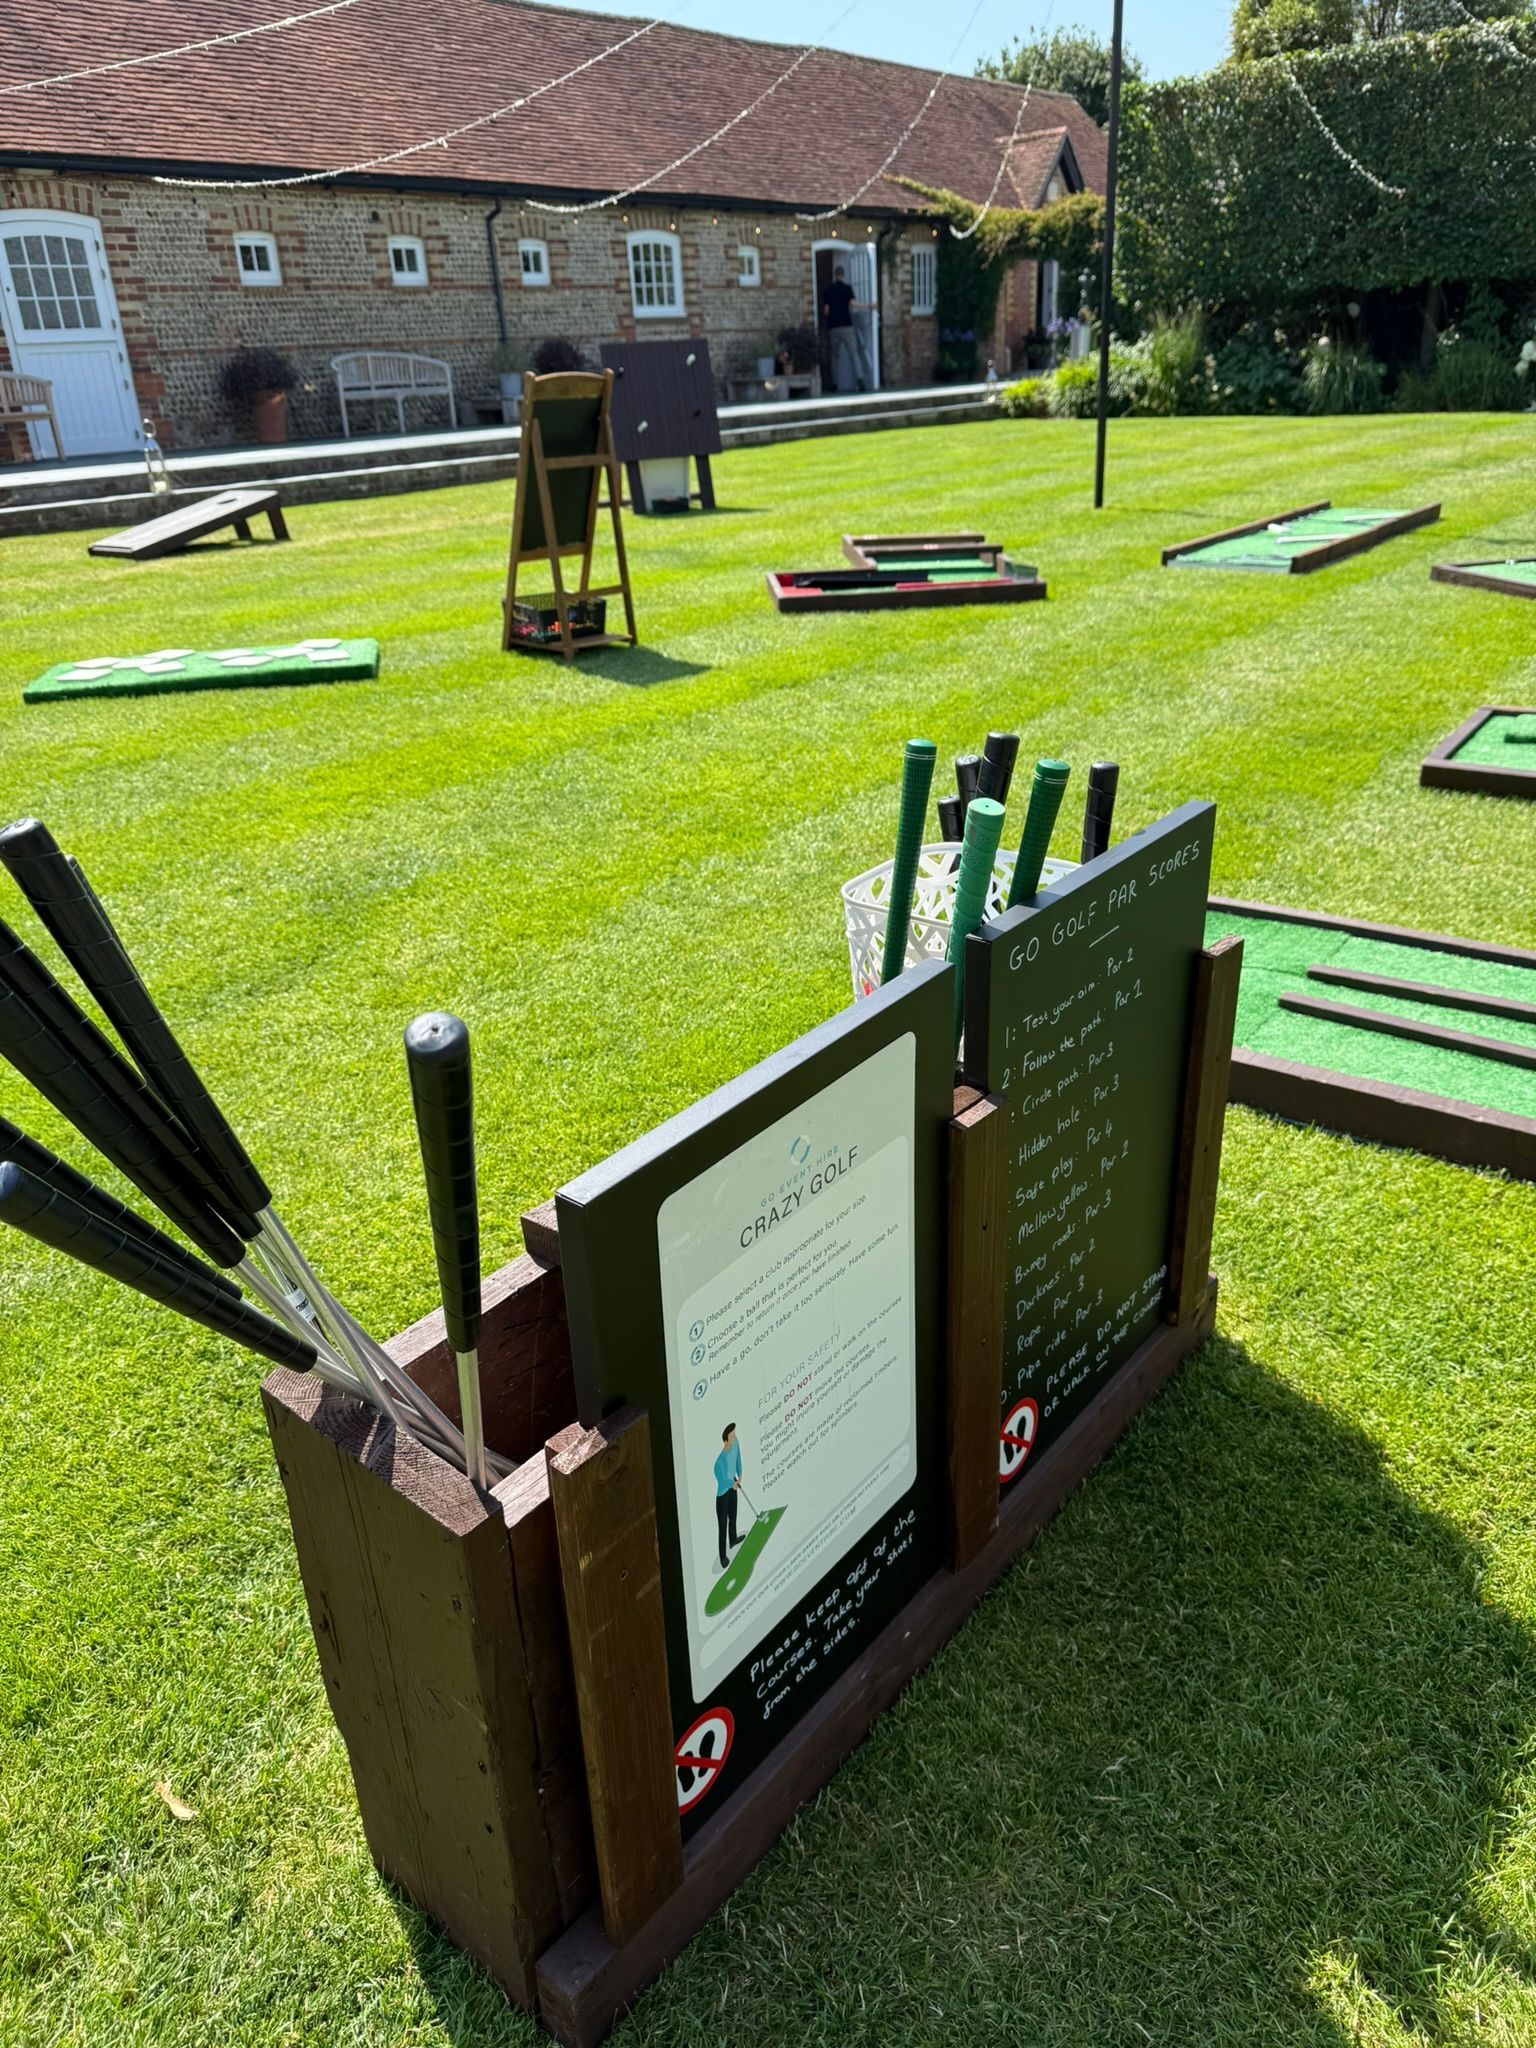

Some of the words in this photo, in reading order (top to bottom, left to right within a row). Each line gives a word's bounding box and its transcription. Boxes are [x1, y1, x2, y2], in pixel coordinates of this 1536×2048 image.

[1009, 936, 1040, 970] GO
[1051, 901, 1097, 945] GOLF
[1108, 880, 1137, 913] PAR
[1148, 840, 1200, 886] SCORES
[1002, 1067, 1017, 1089] 2:
[1022, 1050, 1056, 1078] Follow
[1059, 1035, 1076, 1053] the
[1080, 1007, 1107, 1046] path:
[1115, 990, 1131, 1011] Par
[1133, 978, 1143, 999] 1
[1005, 1026, 1016, 1049] 1:
[1022, 1011, 1049, 1033] Test
[1050, 995, 1075, 1025] your
[1077, 974, 1101, 999] aim:
[1107, 957, 1123, 977] Par
[1127, 947, 1134, 963] 2
[1018, 1133, 1053, 1166] Hidden
[1093, 1086, 1109, 1107] Par
[1111, 1074, 1119, 1091] 3
[1022, 1087, 1052, 1115] Circle
[1057, 1063, 1084, 1096] path:
[1088, 1052, 1105, 1074] Par
[1106, 1041, 1114, 1058] 3
[740, 1185, 803, 1248] CRAZY
[810, 1145, 857, 1194] GOLF
[760, 1192, 776, 1208] GO
[779, 1166, 812, 1194] EVENT
[816, 1144, 838, 1166] HIRE
[1015, 1180, 1045, 1207] Soft
[1051, 1151, 1079, 1185] play:
[1087, 1127, 1101, 1152] Par
[1105, 1119, 1112, 1138] 4
[1101, 1155, 1116, 1178] Par
[1121, 1139, 1129, 1158] 2
[706, 1300, 732, 1326] Please
[734, 1279, 757, 1303] select
[765, 1261, 782, 1278] club
[824, 1218, 835, 1231] for
[836, 1206, 851, 1225] your
[1015, 1253, 1047, 1285] Bumpy
[1085, 1203, 1100, 1224] Par
[1103, 1188, 1111, 1209] 3
[1070, 1251, 1085, 1272] Par
[1088, 1237, 1096, 1253] 2
[693, 1349, 702, 1360] 2
[707, 1320, 737, 1349] Choose
[746, 1299, 760, 1317] ball
[761, 1287, 776, 1304] that
[786, 1259, 811, 1287] perfect
[812, 1250, 822, 1262] for
[709, 1362, 730, 1384] Have
[775, 1311, 792, 1328] take
[800, 1293, 813, 1307] too
[848, 1249, 866, 1267] Have
[867, 1233, 886, 1252] some
[1017, 1359, 1041, 1389] Pipe
[1076, 1303, 1092, 1328] Par
[1096, 1288, 1104, 1306] 3
[1046, 1343, 1089, 1393] PLEASE
[1097, 1320, 1112, 1342] DO
[1116, 1291, 1138, 1320] NOT
[1053, 1291, 1072, 1320] Par
[1078, 1274, 1085, 1292] 3
[758, 1386, 777, 1409] FOR
[779, 1361, 805, 1388] YOUR
[807, 1329, 840, 1365] SAFETY
[758, 1401, 782, 1425] Please
[783, 1388, 795, 1403] DO
[797, 1371, 812, 1391] NOT
[784, 1408, 796, 1422] DO
[797, 1391, 813, 1410] NOT
[1043, 1396, 1061, 1418] OR
[1063, 1365, 1091, 1397] WALK
[1095, 1344, 1110, 1362] ON
[1112, 1322, 1129, 1344] THE
[750, 1629, 800, 1683] Please
[846, 1558, 869, 1586] off
[873, 1536, 888, 1557] of
[893, 1509, 917, 1537] the
[823, 1601, 853, 1631] Take
[855, 1568, 881, 1608] your
[886, 1532, 913, 1566] shots
[763, 1686, 791, 1720] from
[795, 1656, 818, 1683] the
[823, 1616, 861, 1656] sides.
